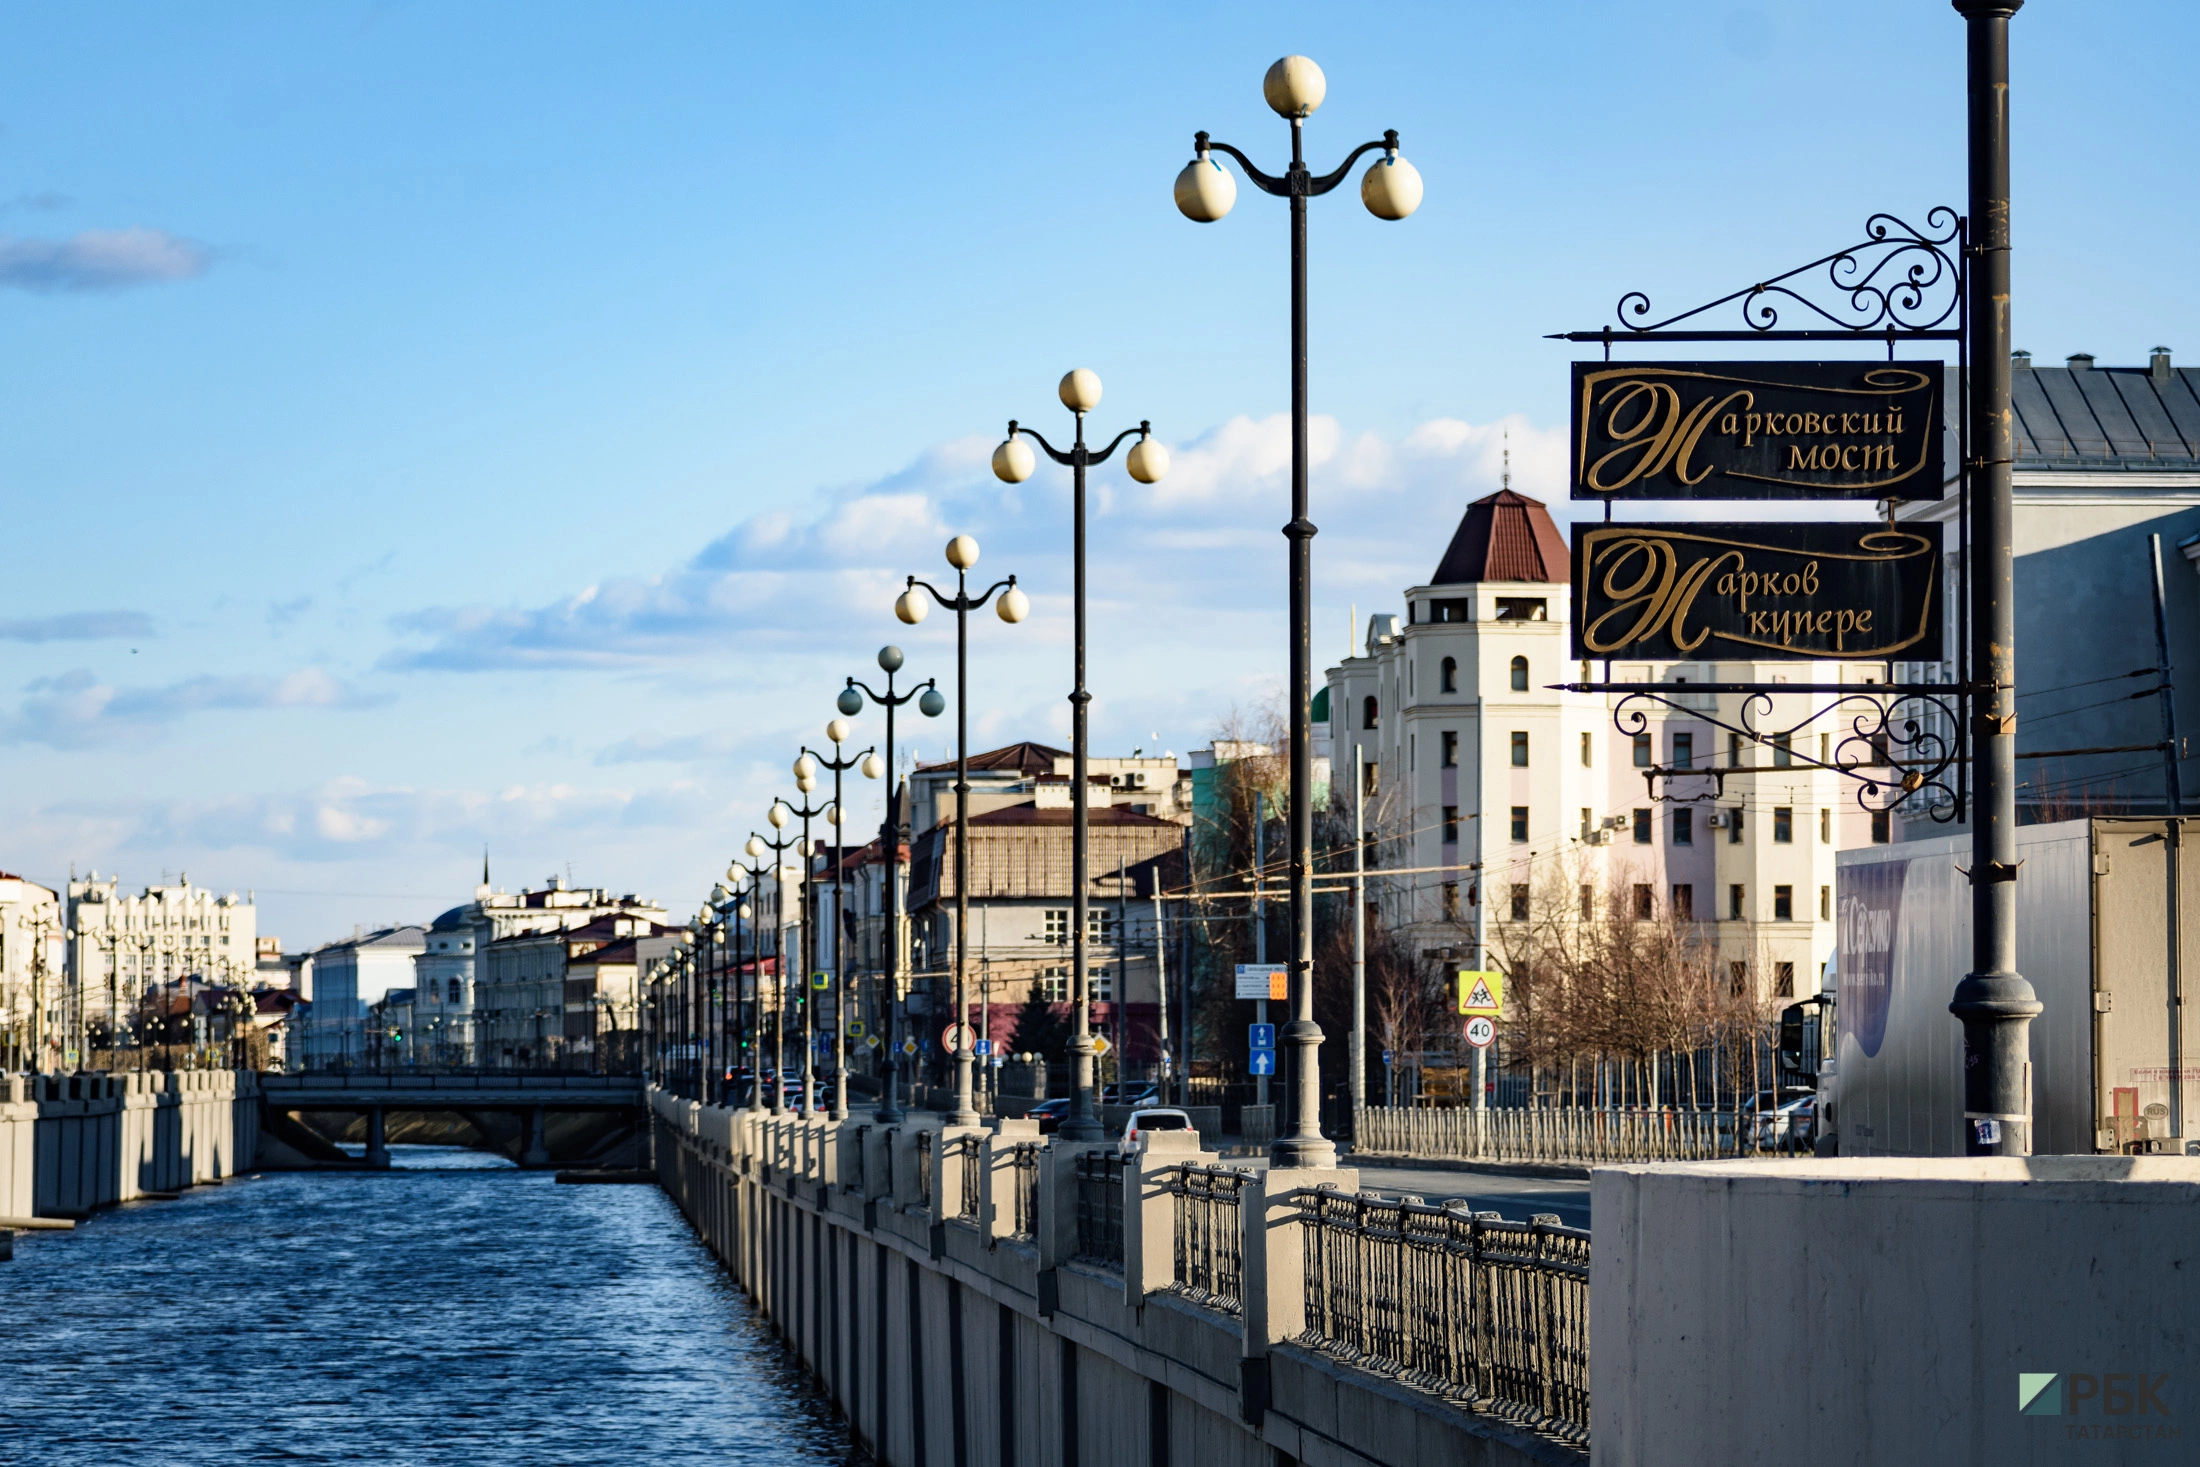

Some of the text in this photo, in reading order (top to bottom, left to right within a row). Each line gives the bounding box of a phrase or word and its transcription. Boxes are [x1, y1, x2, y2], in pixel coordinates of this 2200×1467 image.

[1587, 380, 1905, 491] Жарковский
[1787, 443, 1900, 471] мост
[1584, 538, 1820, 653] Жарков
[1470, 1023, 1490, 1037] 40
[2147, 1107, 2166, 1116] RUS
